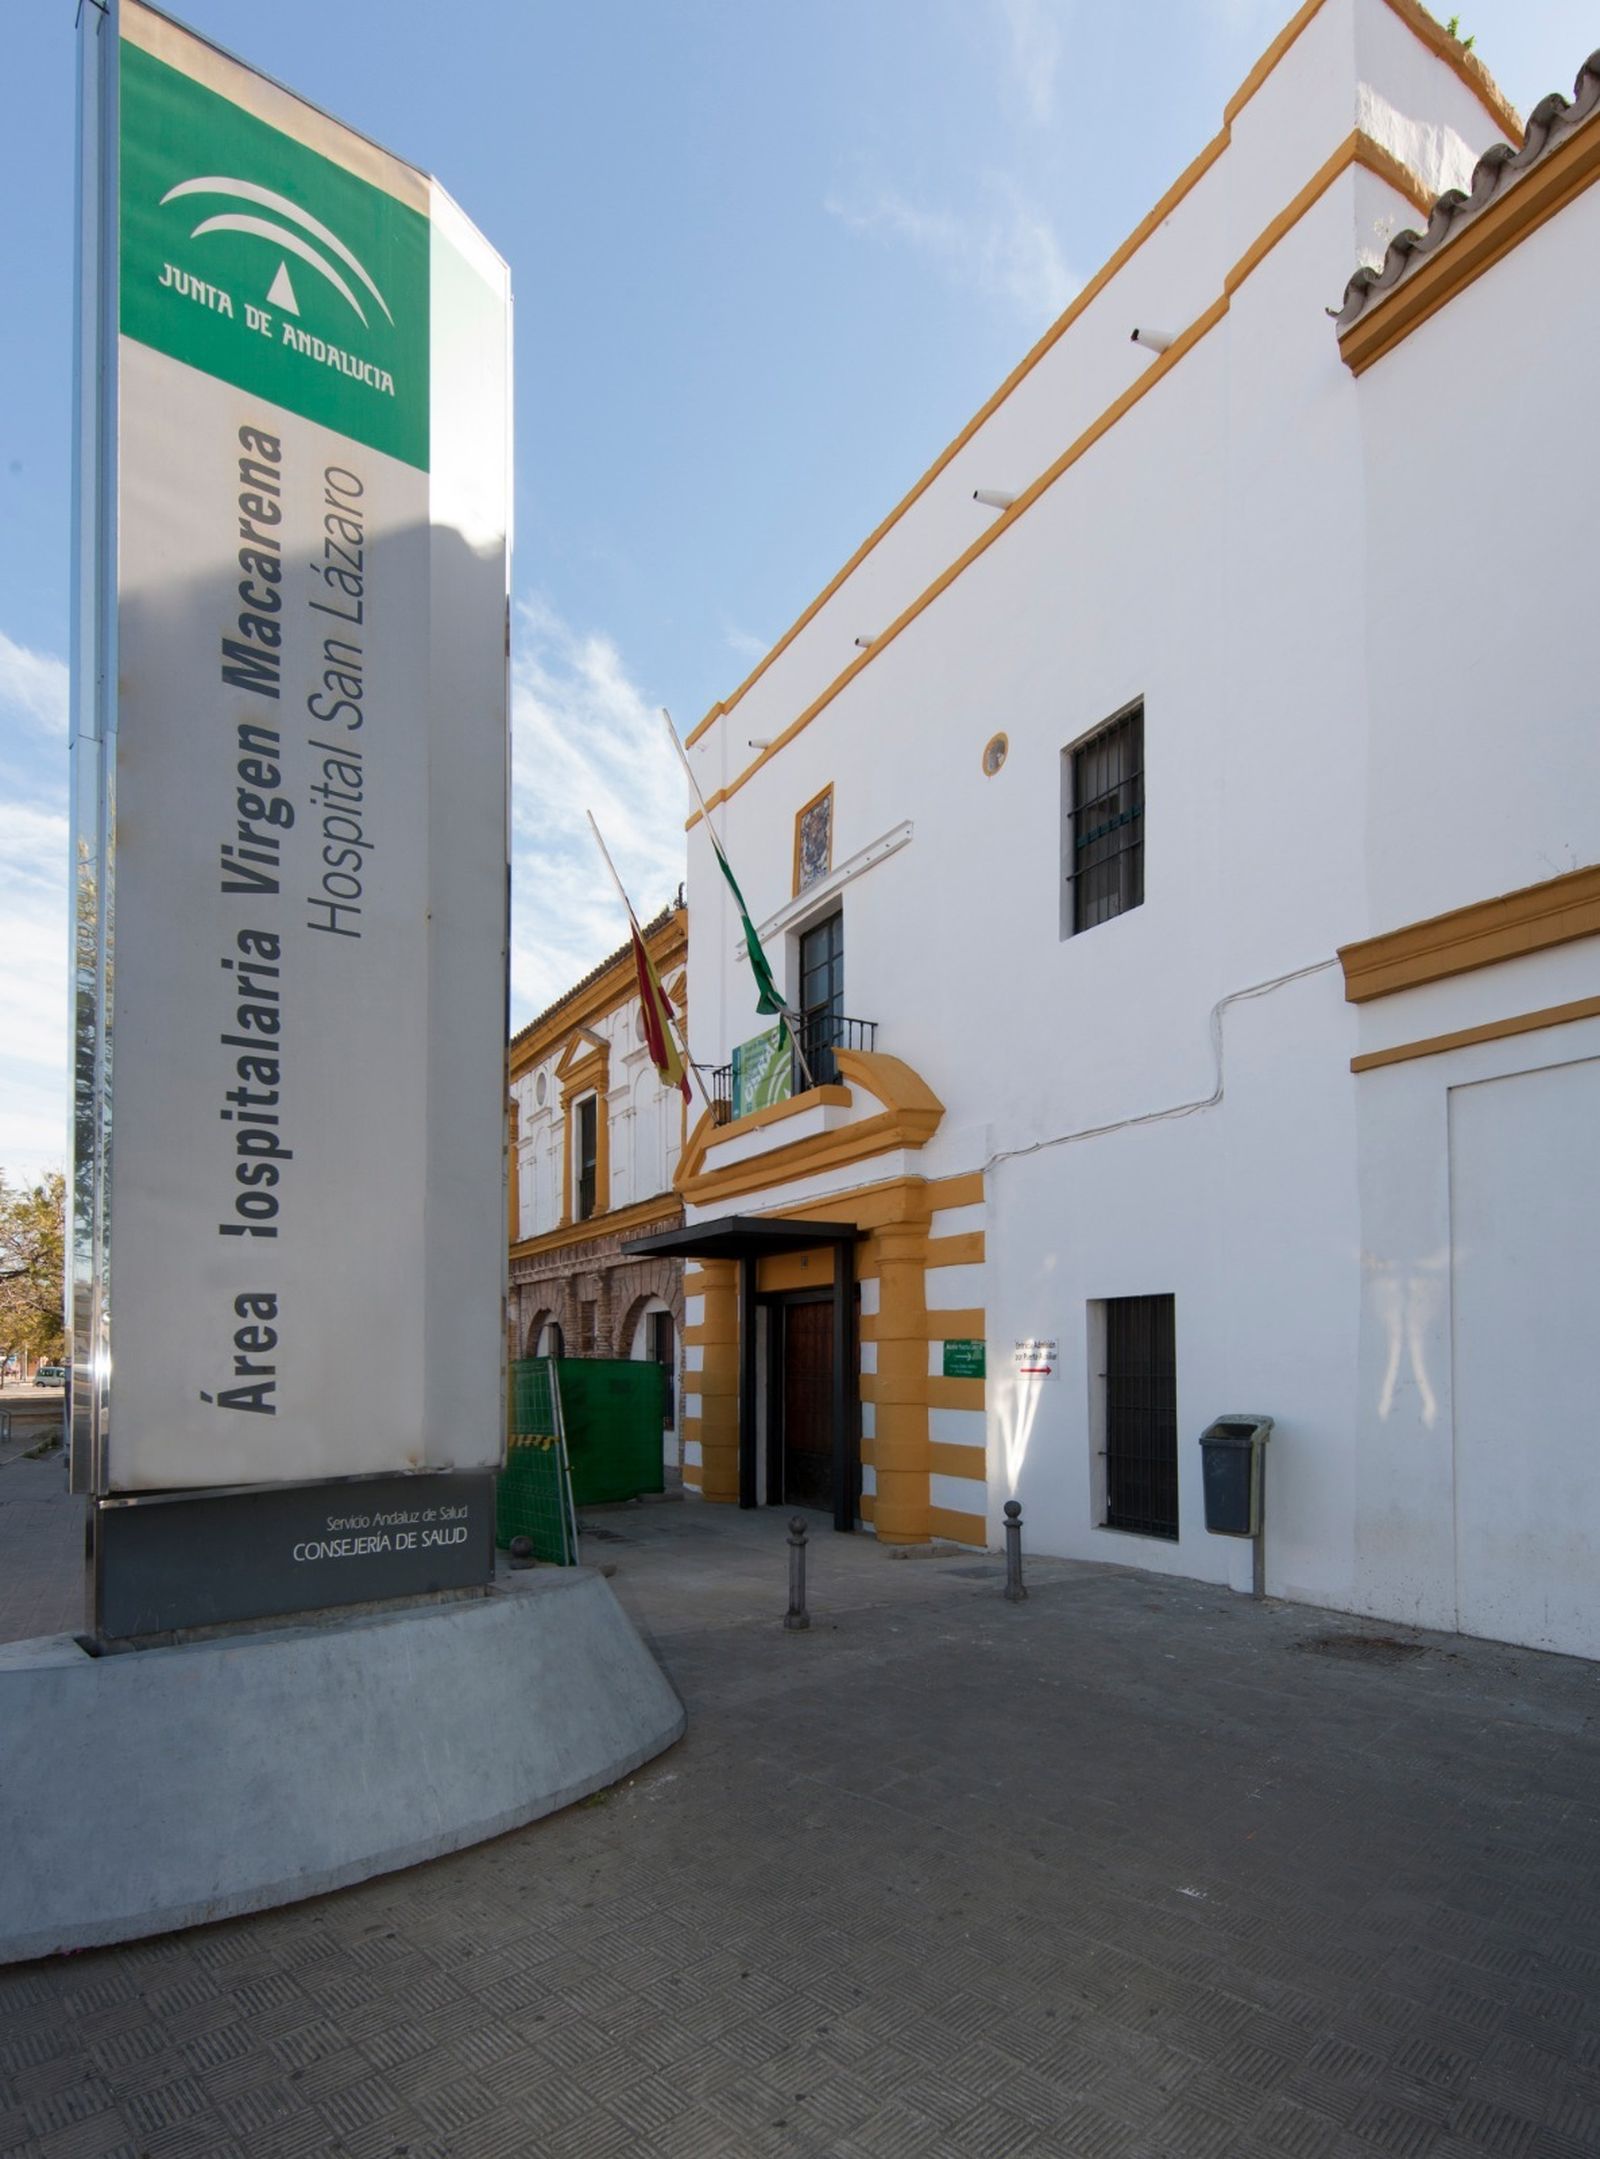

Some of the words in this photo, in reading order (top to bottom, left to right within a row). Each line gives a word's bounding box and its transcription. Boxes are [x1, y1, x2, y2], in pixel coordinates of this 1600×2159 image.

[158, 262, 234, 318] JUNTA
[244, 303, 272, 338] DE
[282, 322, 395, 396] ANDALUCIA
[221, 424, 282, 700] Macarena
[308, 466, 364, 626] Lázaro
[307, 639, 363, 731] San
[220, 723, 295, 895] Virgen
[307, 739, 375, 939] Hospital
[200, 1293, 278, 1416] Área
[293, 1530, 391, 1561] CONSEJERÍA
[396, 1532, 418, 1550] DE
[421, 1526, 468, 1547] SALUD
[327, 1516, 370, 1531] Servicio
[372, 1511, 420, 1527] Andaluz
[422, 1509, 437, 1522] de
[440, 1505, 468, 1520] Salud
